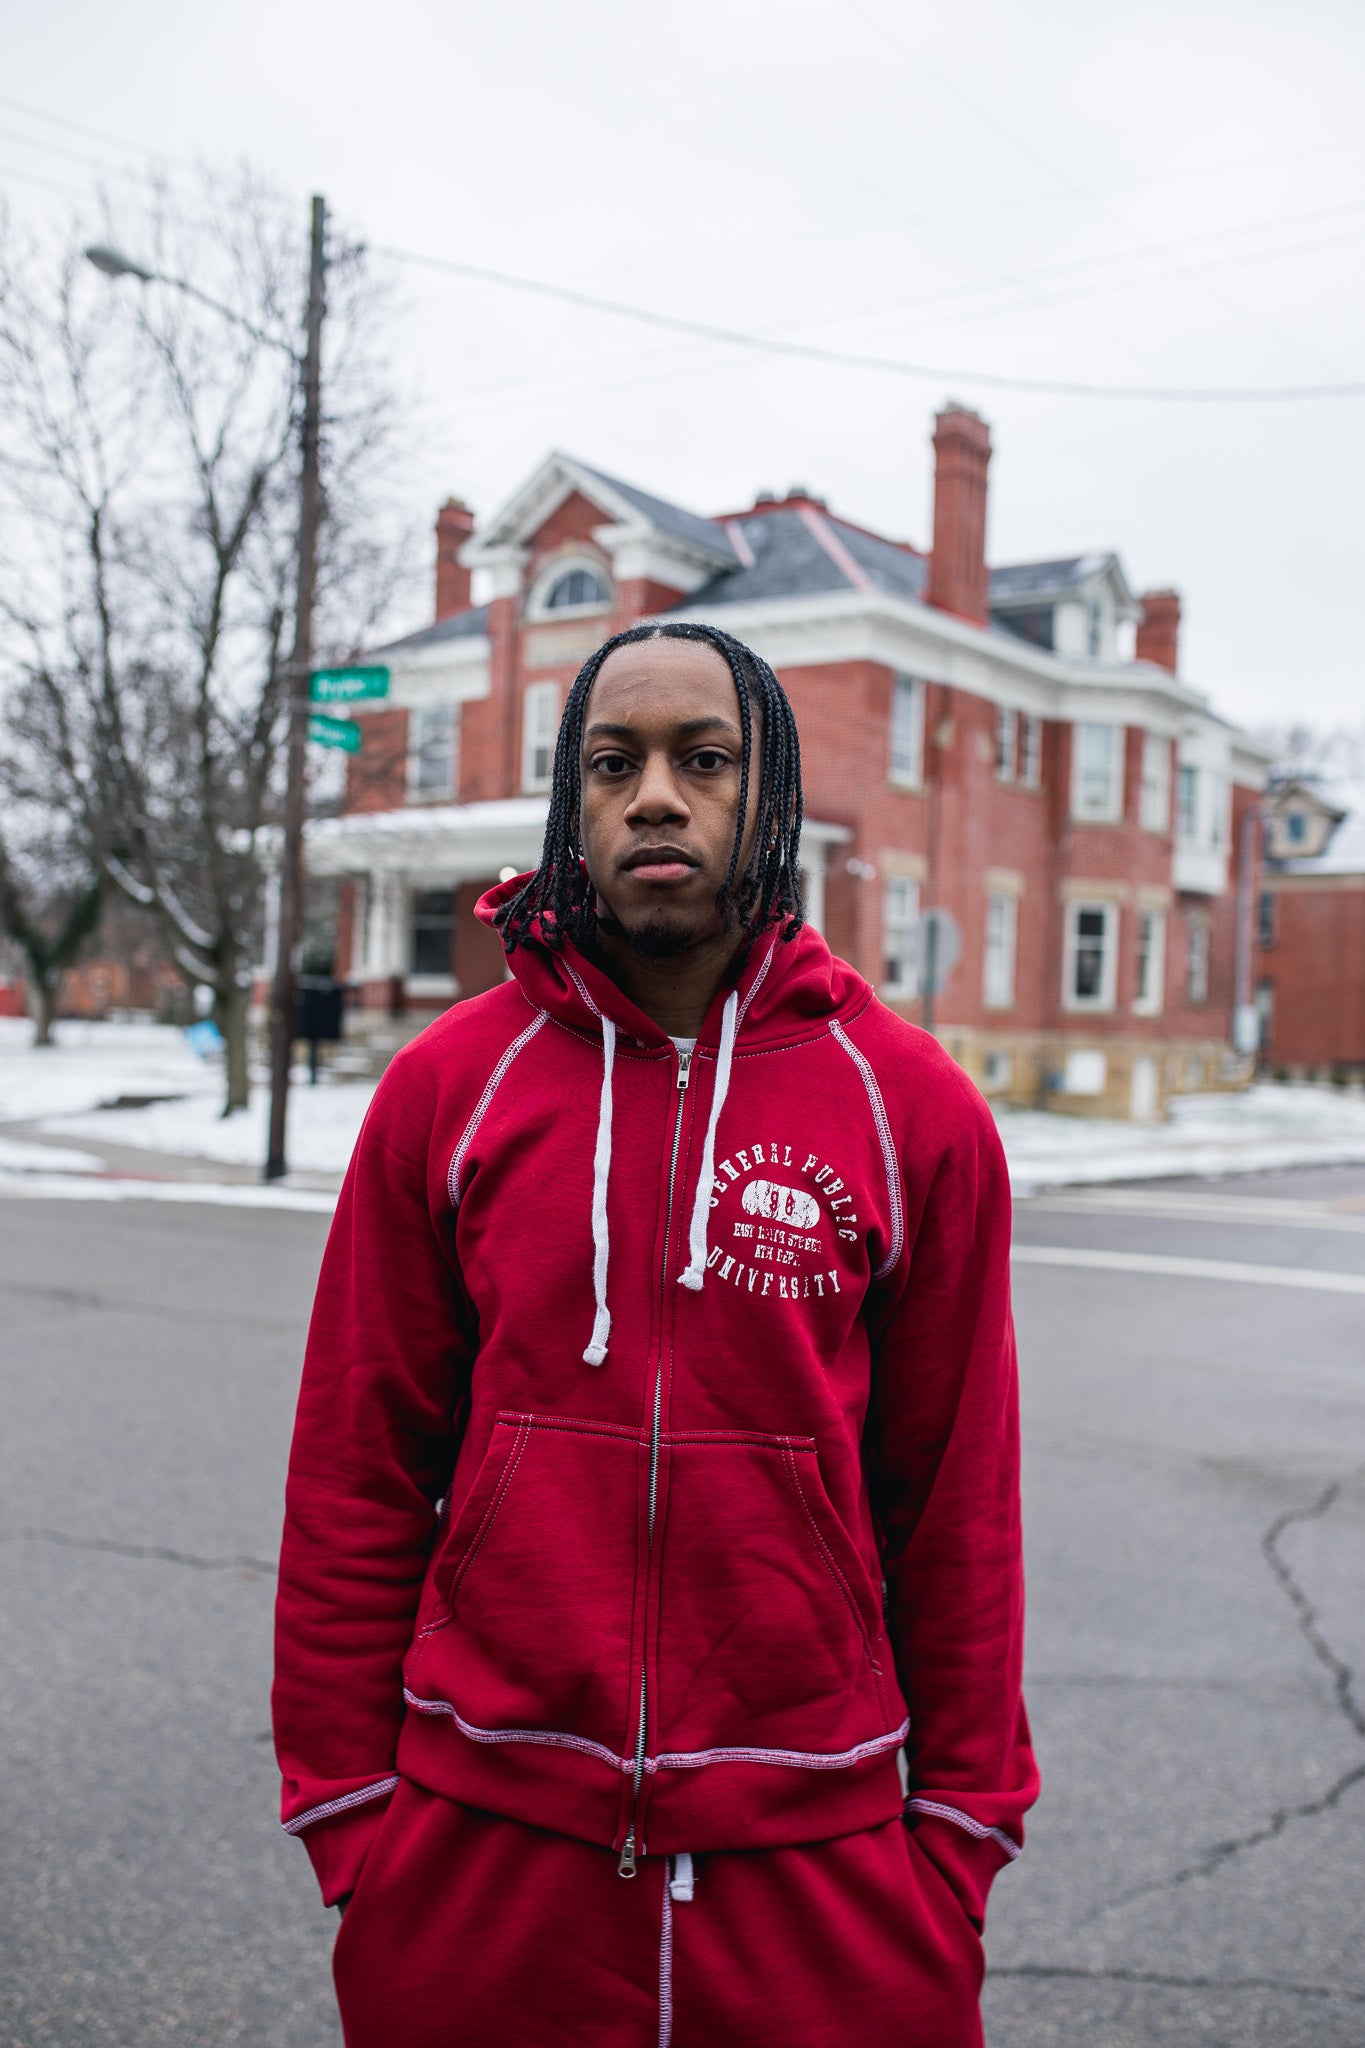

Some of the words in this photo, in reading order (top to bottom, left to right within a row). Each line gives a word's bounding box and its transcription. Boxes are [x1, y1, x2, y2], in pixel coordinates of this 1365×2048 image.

[801, 1153, 857, 1242] PUBLIC
[733, 1222, 756, 1238] EAST
[706, 1245, 841, 1299] UNIVERSITY
